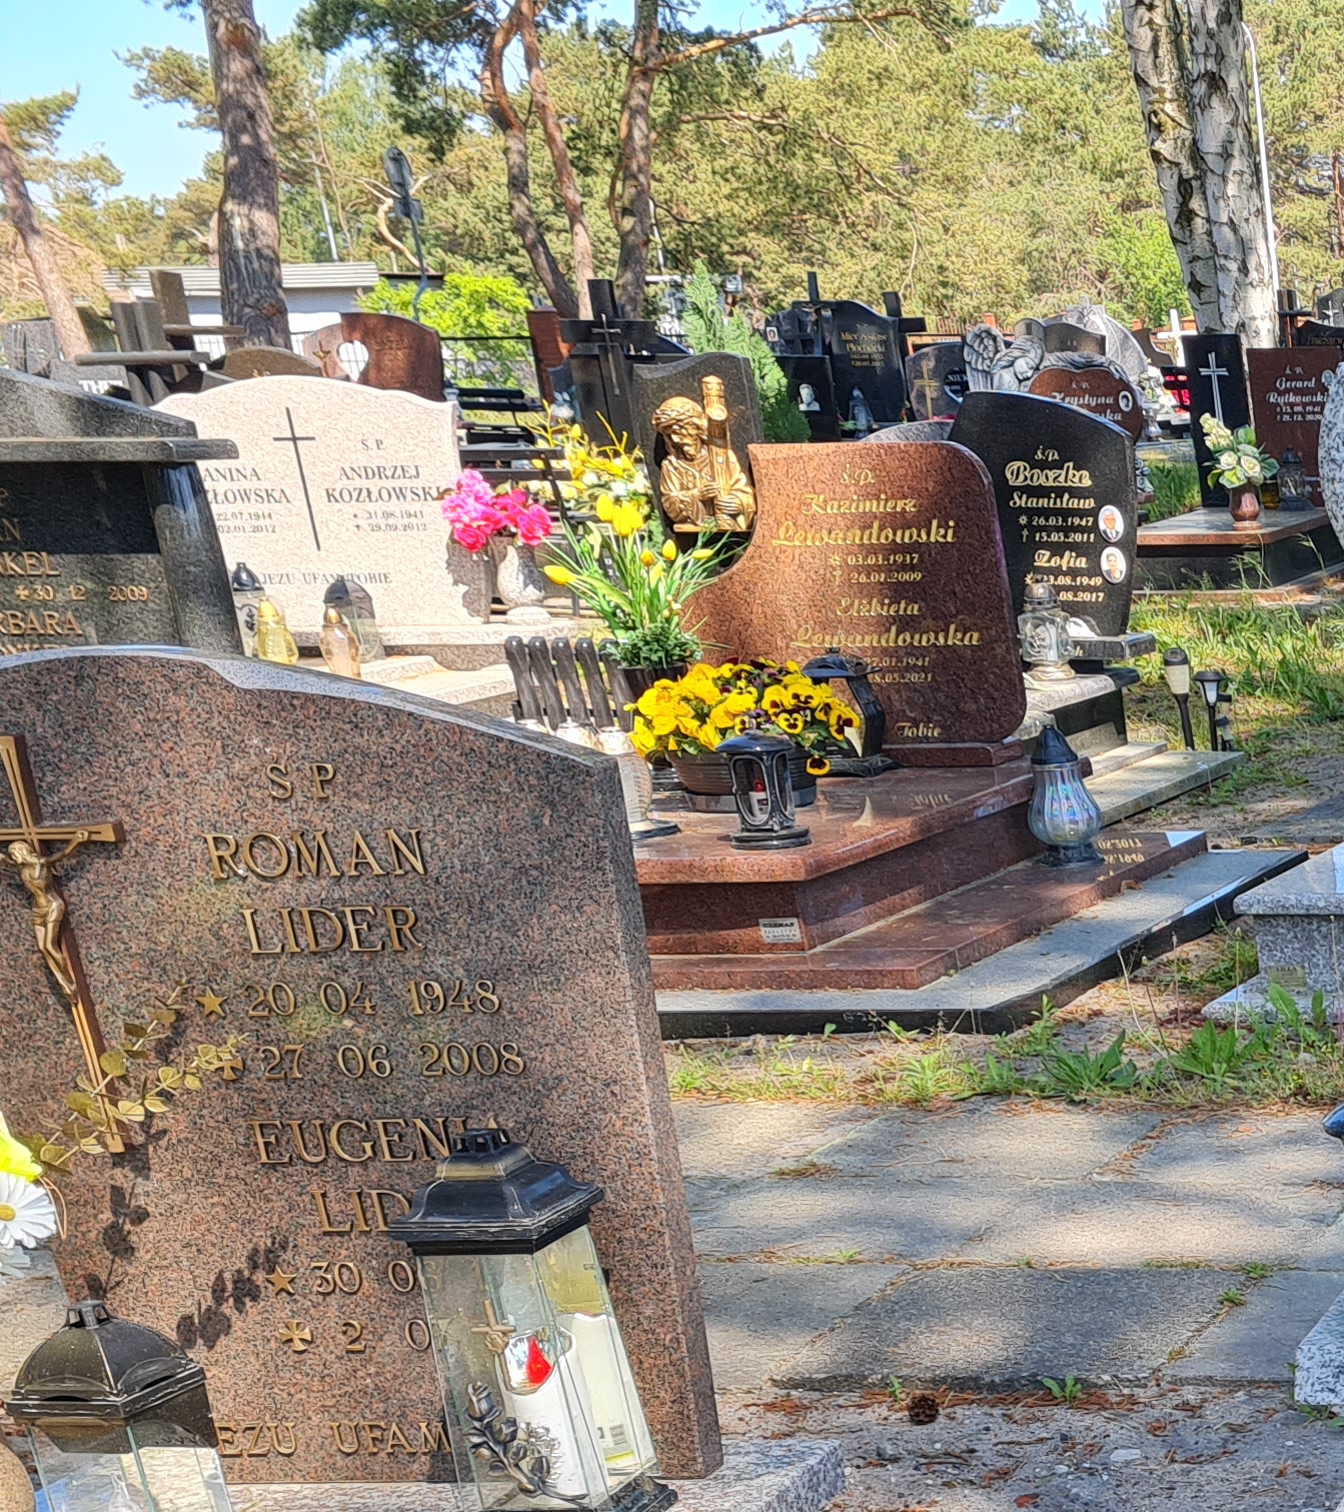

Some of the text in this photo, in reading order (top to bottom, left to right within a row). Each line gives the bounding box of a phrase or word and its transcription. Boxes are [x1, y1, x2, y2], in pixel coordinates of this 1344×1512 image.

[1275, 376, 1317, 391] Gerard
[203, 466, 262, 483] ANINA
[338, 464, 421, 481] ANDRZEJ
[1005, 461, 1093, 488] Boszke
[325, 486, 442, 504] KOZŁOWSKI
[802, 493, 918, 515] Kazimierz
[1009, 490, 1097, 509] Stanisław
[1031, 515, 1095, 527] 26.03.1947
[771, 519, 957, 547] Lewandowski
[1034, 531, 1096, 543] 15.05.2011
[847, 553, 920, 566] 03.03.1937
[1033, 549, 1089, 571] Zofia
[850, 571, 923, 583] 26.01.2009
[68, 584, 88, 602] 12
[836, 596, 922, 617] Elżbieta
[789, 622, 982, 649] Lewandowska
[894, 721, 943, 738] Tobie
[308, 762, 336, 799] P
[202, 827, 429, 881] ROMAN
[240, 905, 428, 956] LIDER
[244, 979, 502, 1018] 20 04 1948
[258, 1041, 526, 1081] 27 06 2008
[310, 1260, 364, 1295] 30
[341, 1320, 367, 1352] 2
[214, 1422, 452, 1457] EZU UFAM
